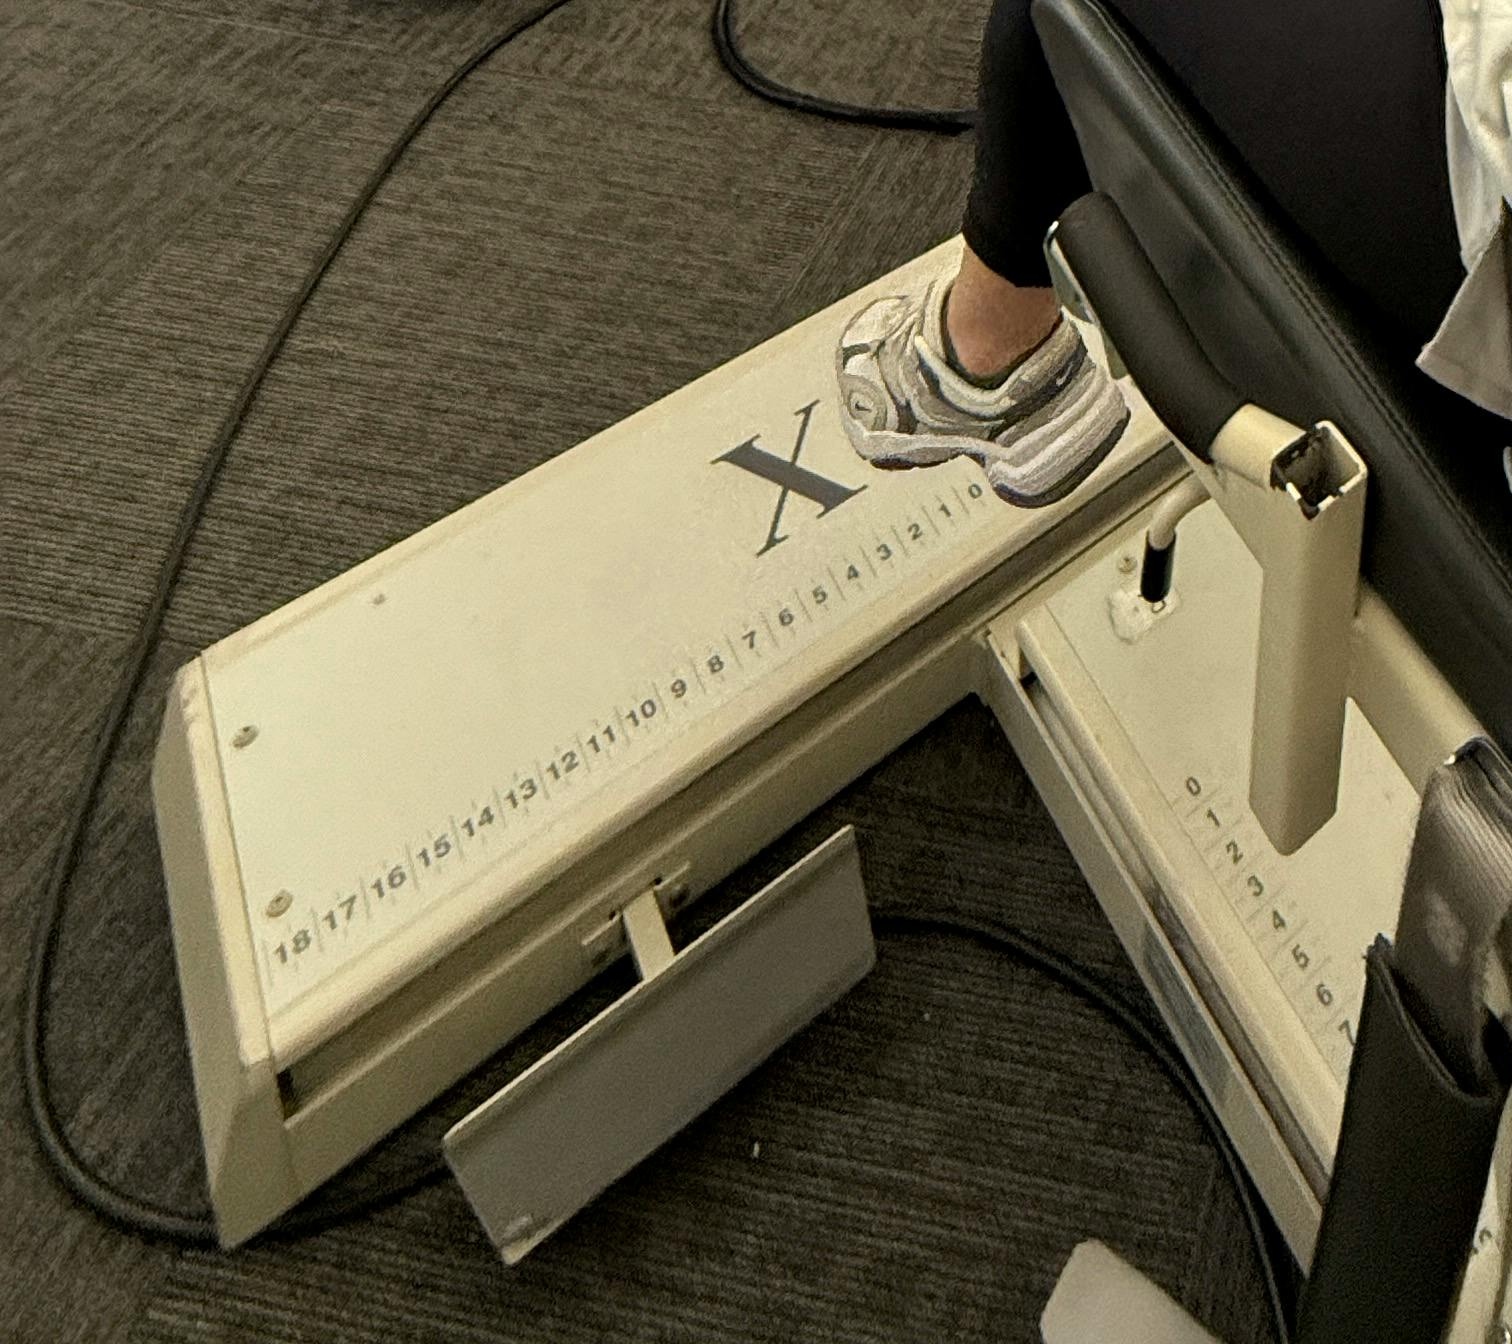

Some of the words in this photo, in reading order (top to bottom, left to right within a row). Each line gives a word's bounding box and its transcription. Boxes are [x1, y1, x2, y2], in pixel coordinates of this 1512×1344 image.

[710, 399, 869, 558] X
[273, 928, 311, 963] 18
[322, 895, 357, 930] 17
[370, 865, 407, 898] 16
[416, 833, 452, 867] 15
[461, 805, 495, 837] 14
[504, 778, 539, 809] 13
[547, 750, 580, 781] 12
[586, 725, 616, 753] 11
[625, 699, 657, 728] 10
[670, 679, 687, 699] 9
[707, 655, 725, 674] 8
[741, 630, 757, 650] 7
[778, 608, 794, 627] 6
[812, 585, 828, 604] 5
[847, 564, 860, 581] 4
[876, 543, 892, 561] 3
[908, 522, 923, 540] 2
[939, 503, 951, 518] 1
[967, 483, 983, 500] 0
[1185, 776, 1202, 798] 0
[1207, 808, 1221, 828] 1
[1226, 840, 1243, 864] 2
[1247, 875, 1264, 898] 3
[1271, 909, 1286, 932] 4
[1292, 944, 1310, 970] 5
[1315, 983, 1333, 1007] 6
[1338, 1019, 1356, 1047] 7
